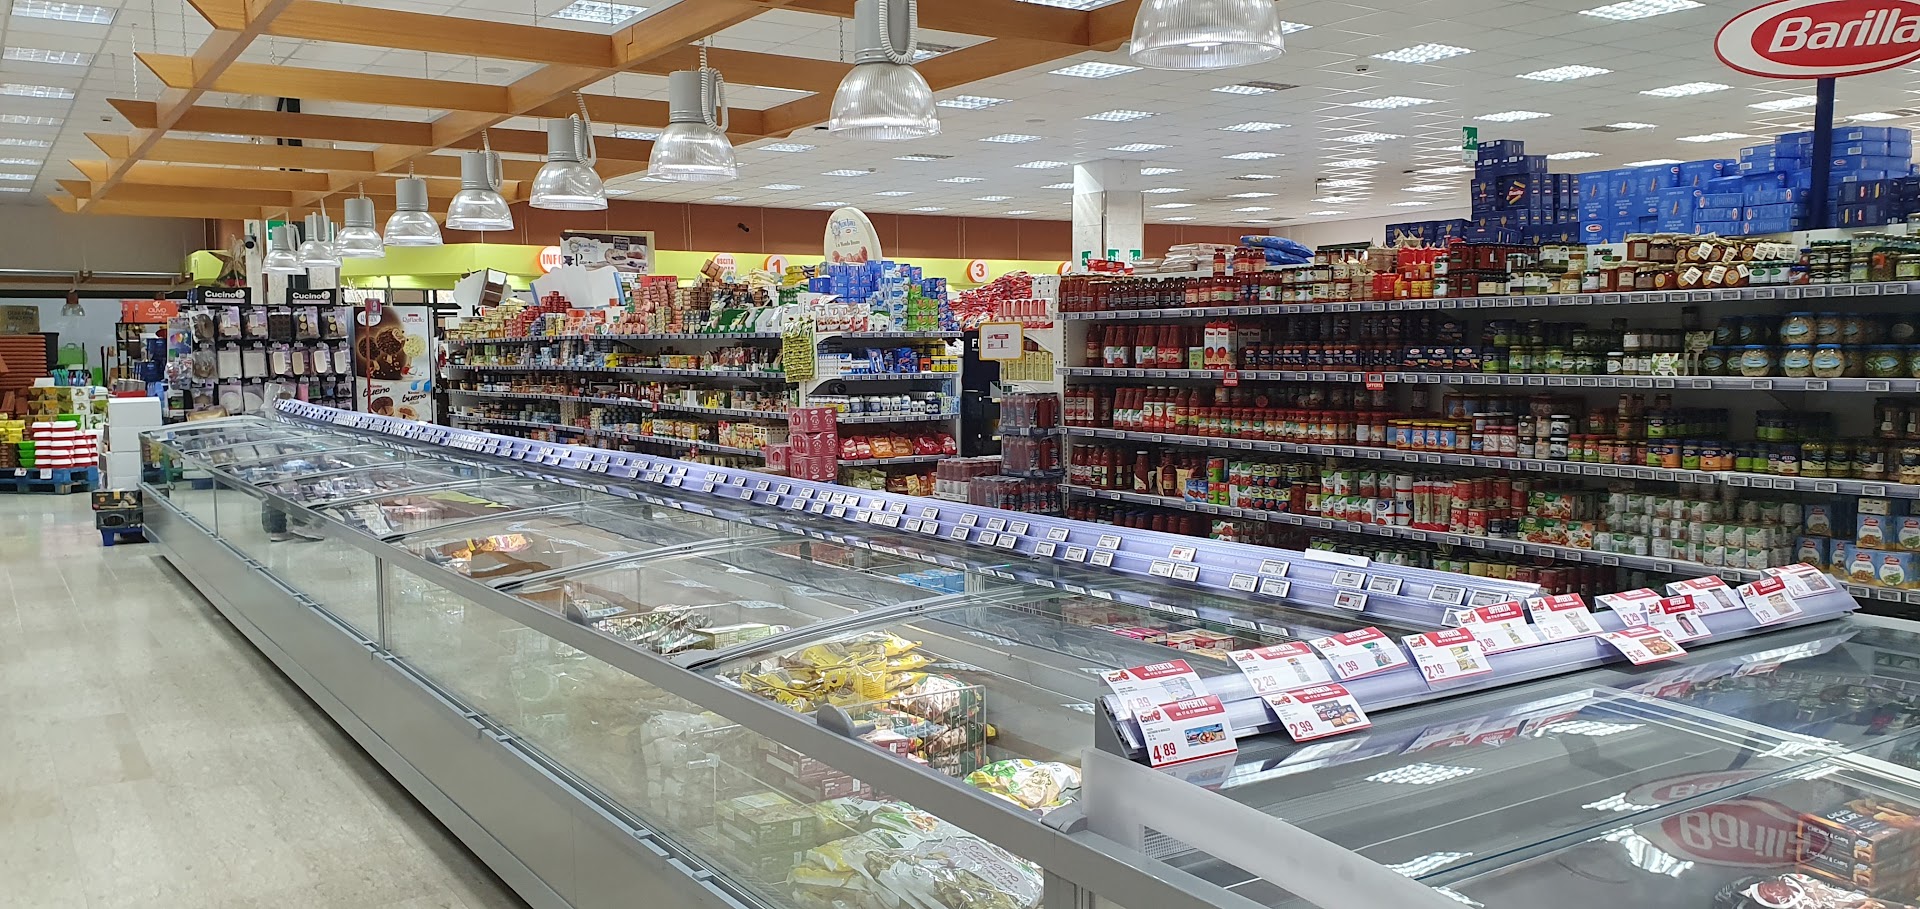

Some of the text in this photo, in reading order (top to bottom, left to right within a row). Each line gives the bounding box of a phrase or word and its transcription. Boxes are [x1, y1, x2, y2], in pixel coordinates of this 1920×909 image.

[1768, 8, 1920, 53] Barilla
[772, 259, 781, 276] 1
[975, 263, 986, 278] 3
[205, 290, 236, 298] Cucino
[292, 292, 322, 300] Cucino
[972, 339, 980, 348] F
[363, 386, 390, 398] bueno
[402, 393, 427, 403] bueno
[1487, 604, 1511, 614] OFFERTA
[1343, 629, 1370, 638] OFFERTA
[1437, 630, 1462, 639] OFFERTA
[1267, 644, 1295, 654] OFFERTA
[1144, 662, 1175, 672] OFFERTA
[1424, 663, 1445, 680] 2,19
[1304, 686, 1332, 695] OFFERTA
[1178, 699, 1208, 711] OFFERTA
[1289, 720, 1314, 738] 2,99
[1153, 742, 1178, 763] 4,89
[969, 845, 1019, 882] Contorno
